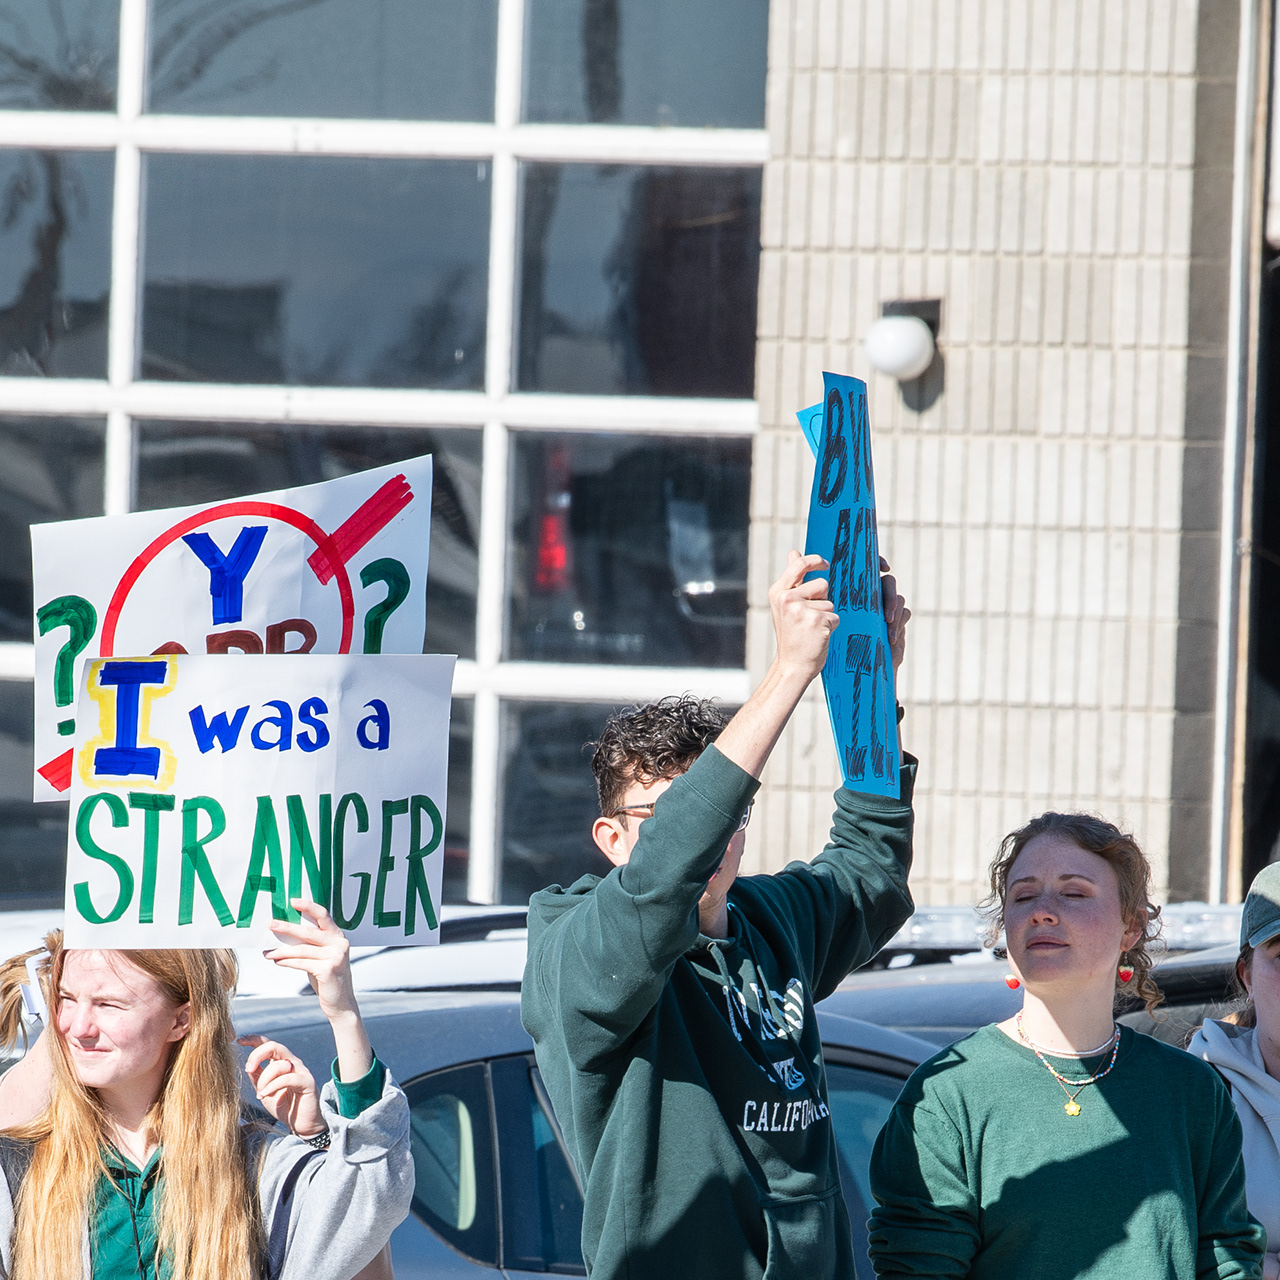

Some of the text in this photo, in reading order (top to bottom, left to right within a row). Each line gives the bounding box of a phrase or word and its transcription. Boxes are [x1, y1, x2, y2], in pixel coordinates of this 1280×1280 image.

[181, 525, 269, 625] Y
[94, 661, 390, 780] I was a
[73, 791, 443, 936] STRANGER
